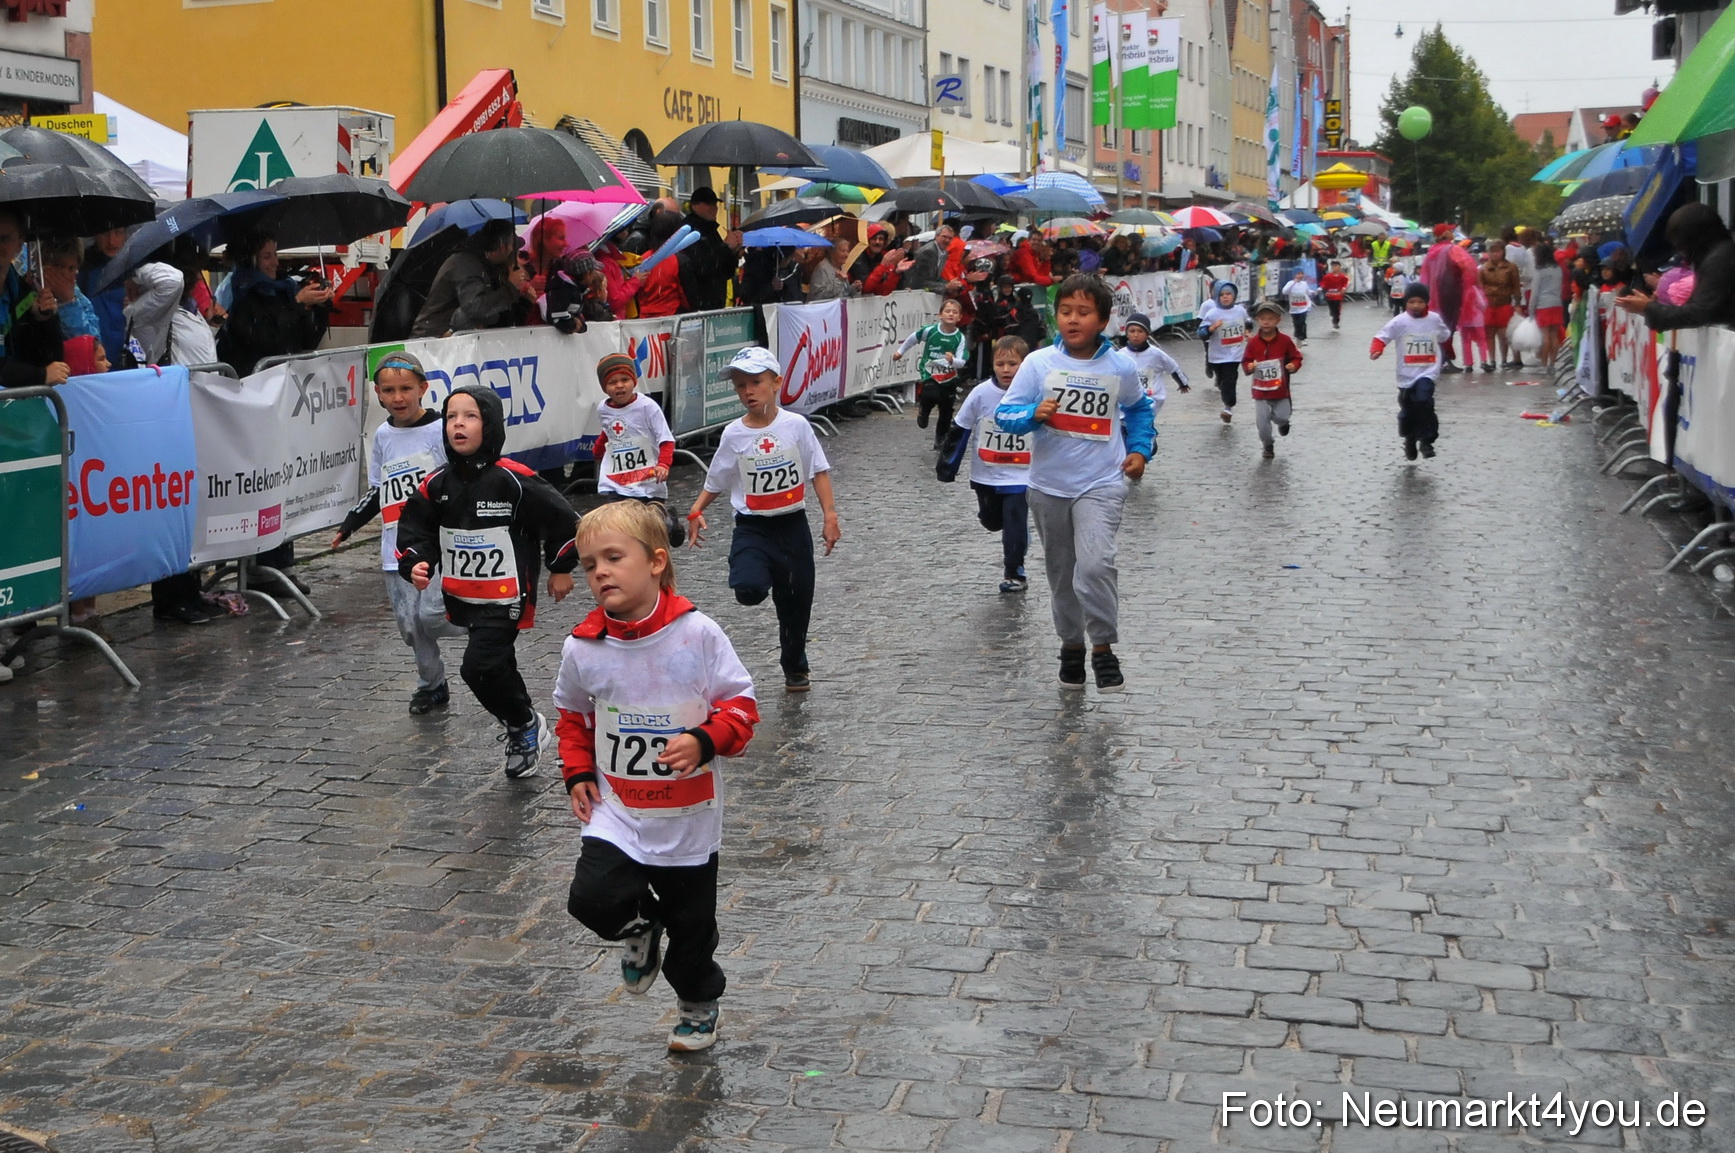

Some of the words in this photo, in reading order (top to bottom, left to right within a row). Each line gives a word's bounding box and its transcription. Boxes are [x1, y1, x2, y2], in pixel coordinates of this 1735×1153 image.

[15, 68, 75, 87] KINDERMODEN
[664, 87, 693, 123] CAFE
[46, 119, 93, 130] Duschen
[1326, 101, 1341, 147] HOT
[1406, 342, 1433, 354] 7114
[291, 365, 356, 425] Xplus1
[1066, 376, 1098, 385] BOCK
[1052, 387, 1110, 416] 7288
[985, 431, 1025, 451] 7145
[208, 474, 231, 498] Ihr
[296, 456, 307, 478] 2x
[310, 452, 317, 474] in
[320, 443, 357, 471] Neumarkt
[747, 462, 800, 494] 7225
[68, 458, 194, 520] eCenter
[383, 469, 426, 504] 7035
[260, 512, 280, 530] Partner
[447, 549, 506, 578] 7222
[619, 713, 671, 726] BOCK
[606, 731, 675, 777] 723
[615, 780, 674, 800] Vincent
